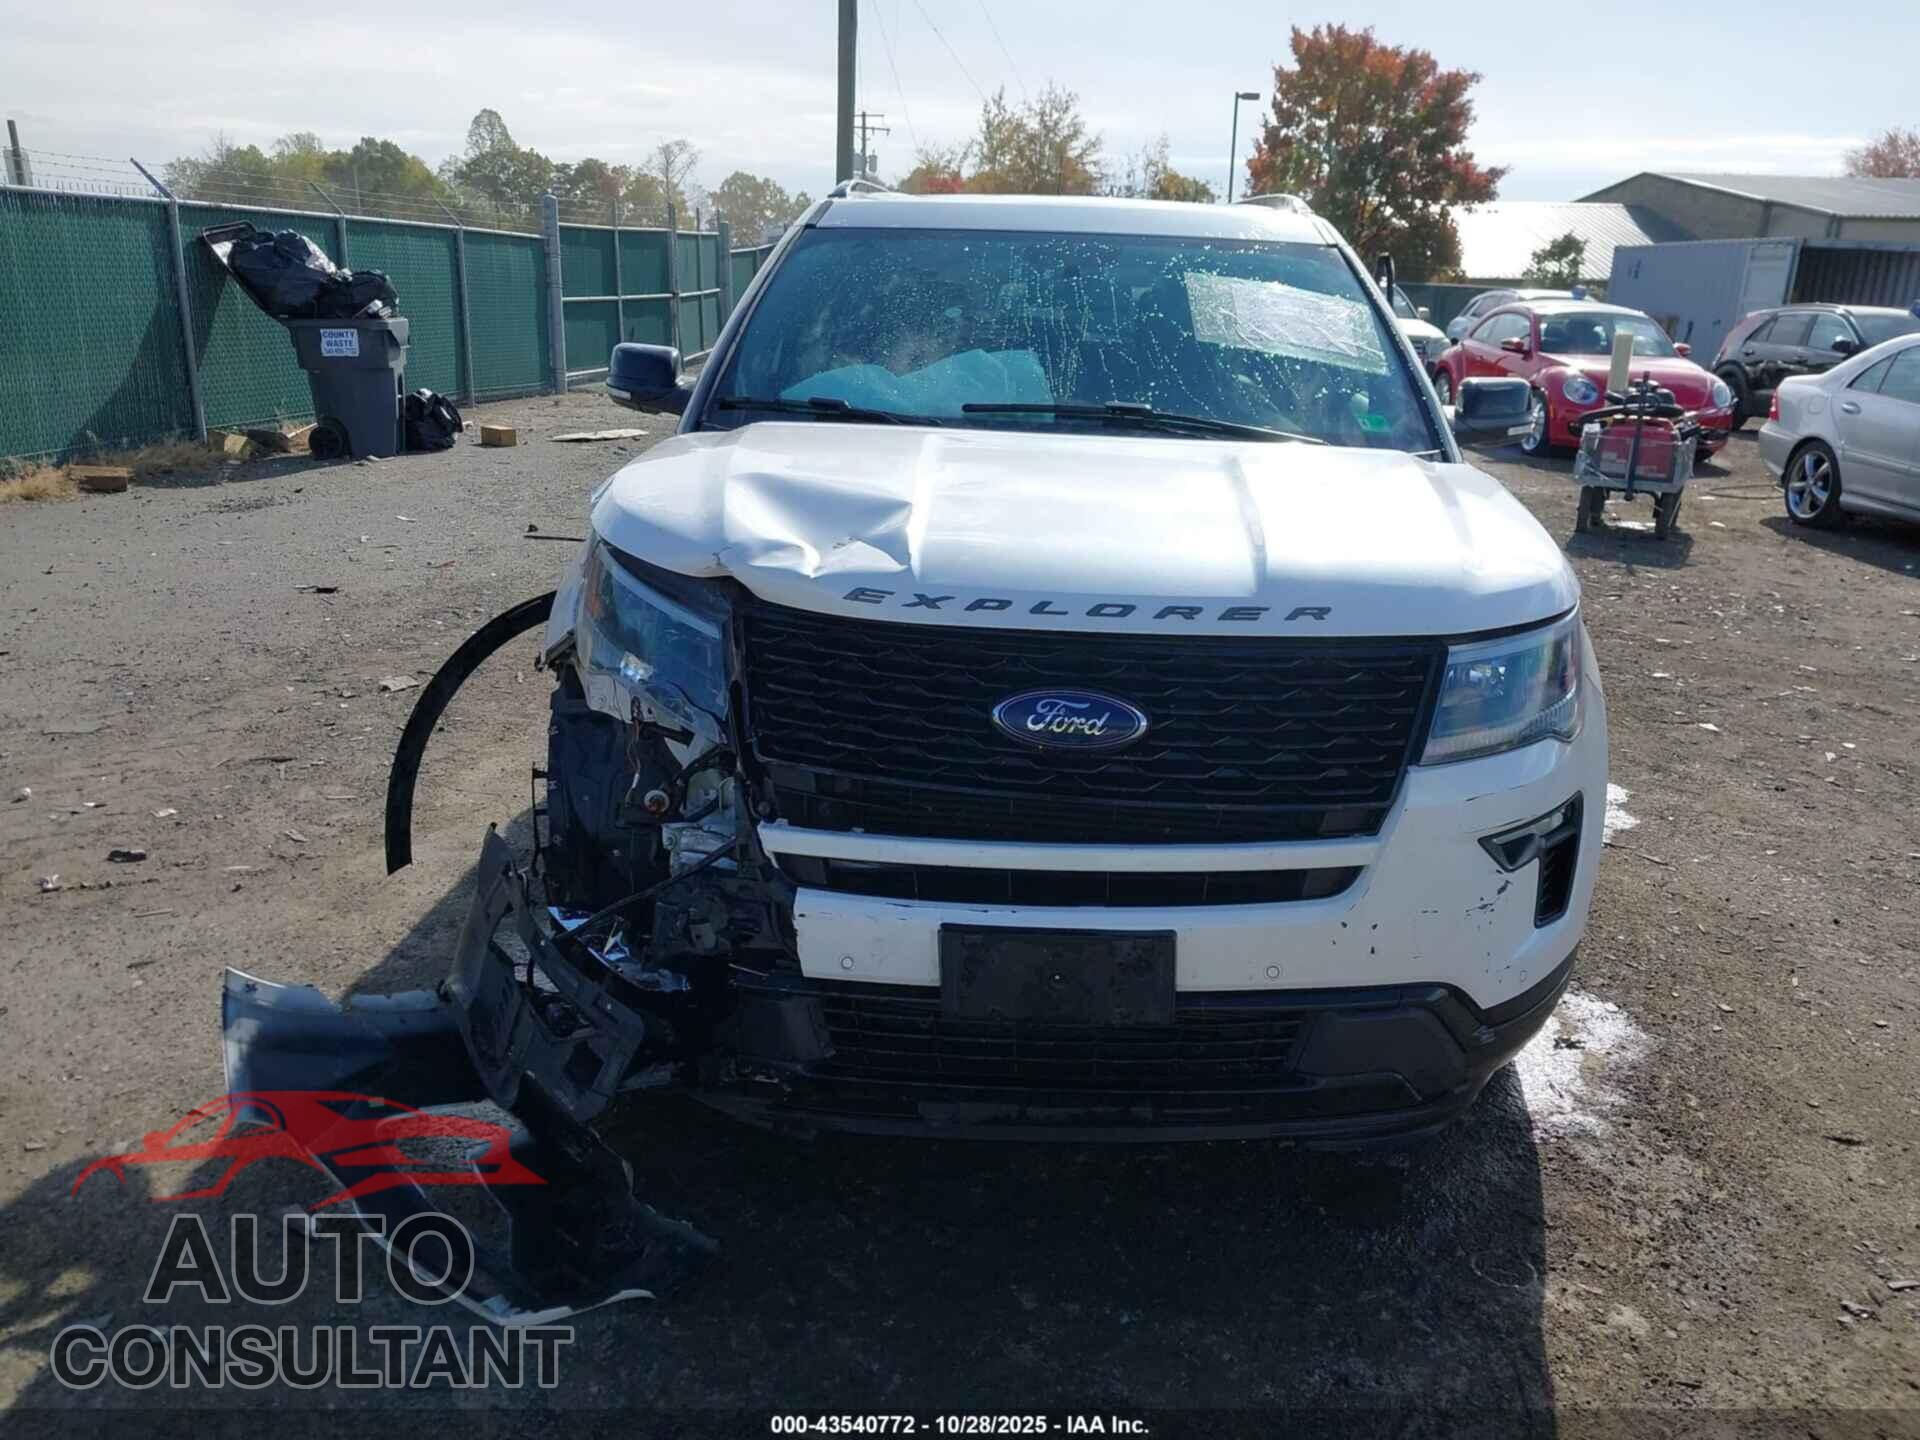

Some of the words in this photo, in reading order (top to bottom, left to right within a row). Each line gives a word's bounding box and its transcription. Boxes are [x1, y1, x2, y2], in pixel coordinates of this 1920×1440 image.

[322, 330, 355, 338] COUNTY
[326, 339, 354, 347] WASTE
[842, 586, 1333, 622] EXPLORER
[1026, 698, 1111, 737] Ford
